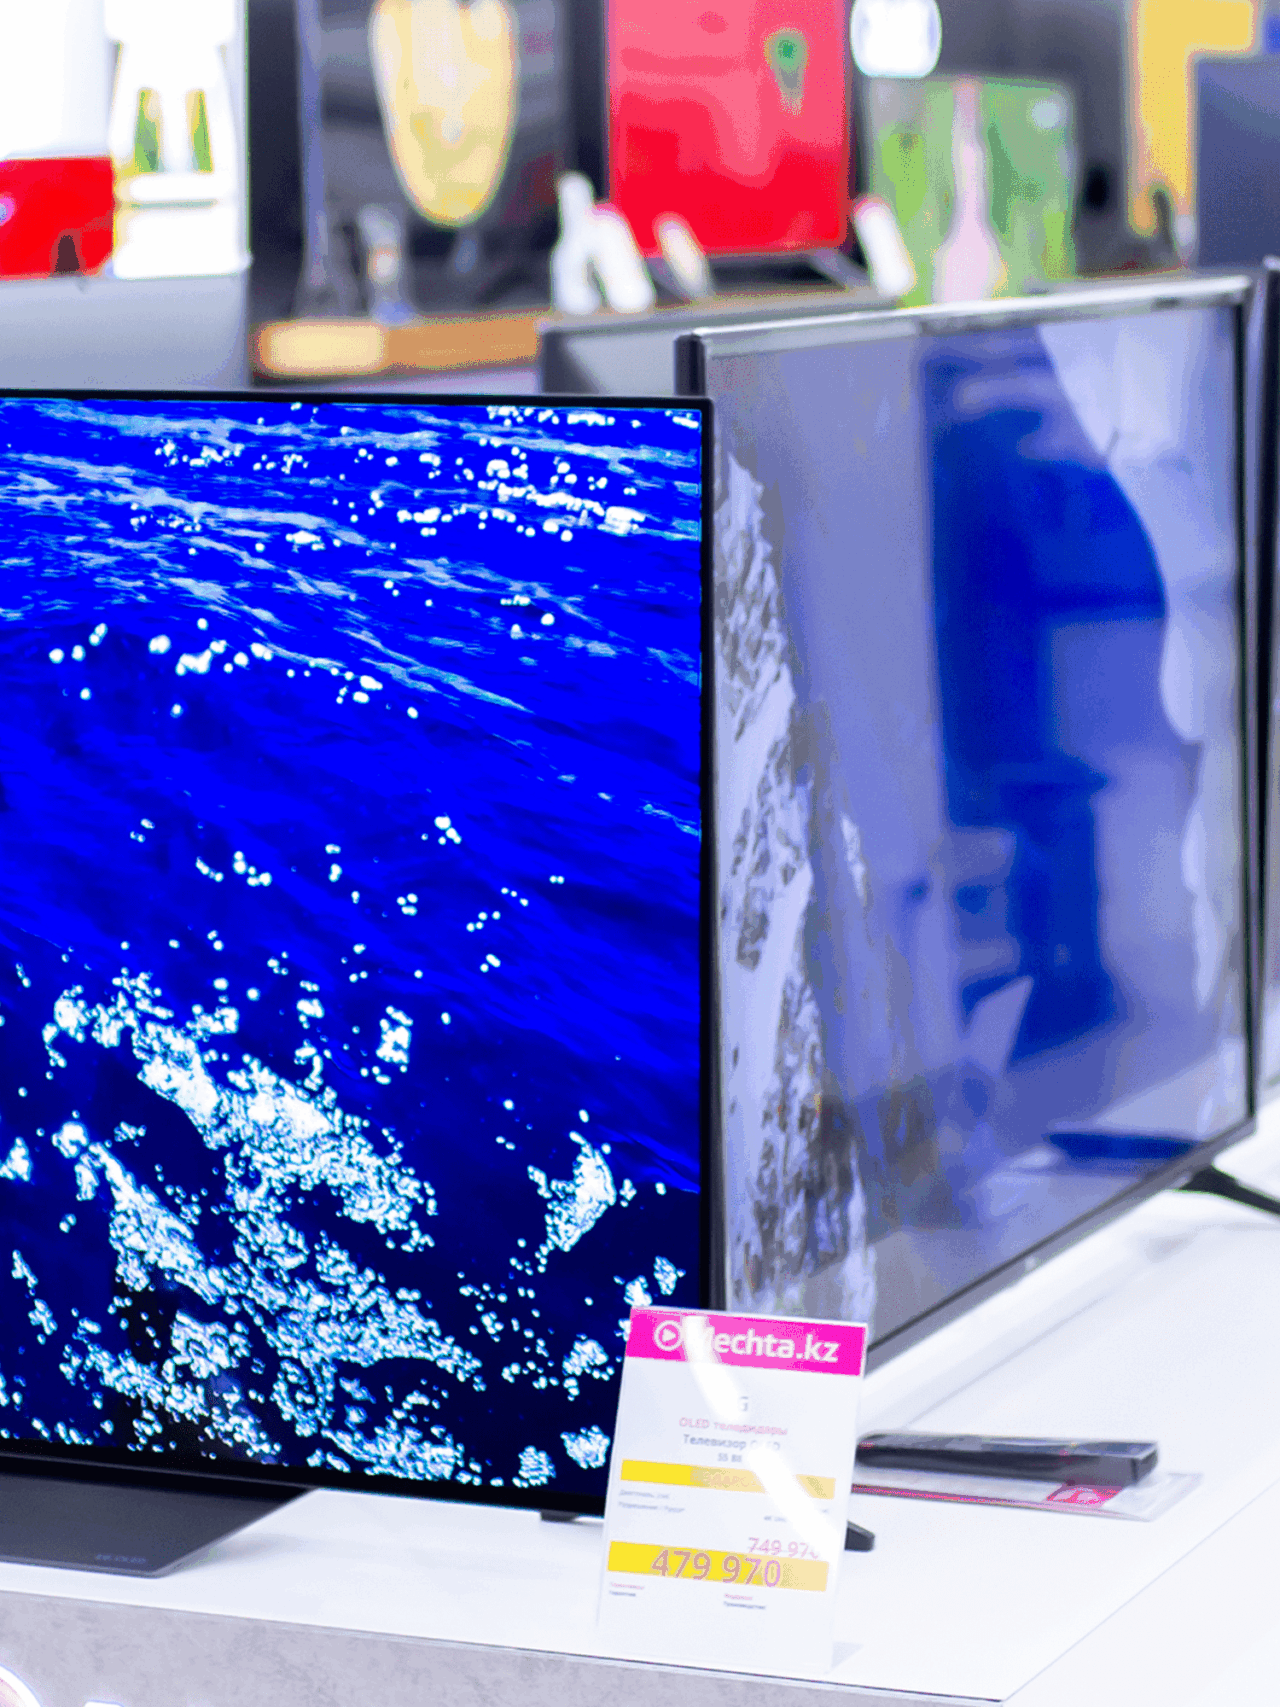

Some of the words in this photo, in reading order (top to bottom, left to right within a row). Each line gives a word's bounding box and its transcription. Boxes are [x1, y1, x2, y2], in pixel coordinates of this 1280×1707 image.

[683, 1433, 747, 1451] Телевизор
[651, 1549, 712, 1581] 479
[722, 1555, 782, 1588] 970
